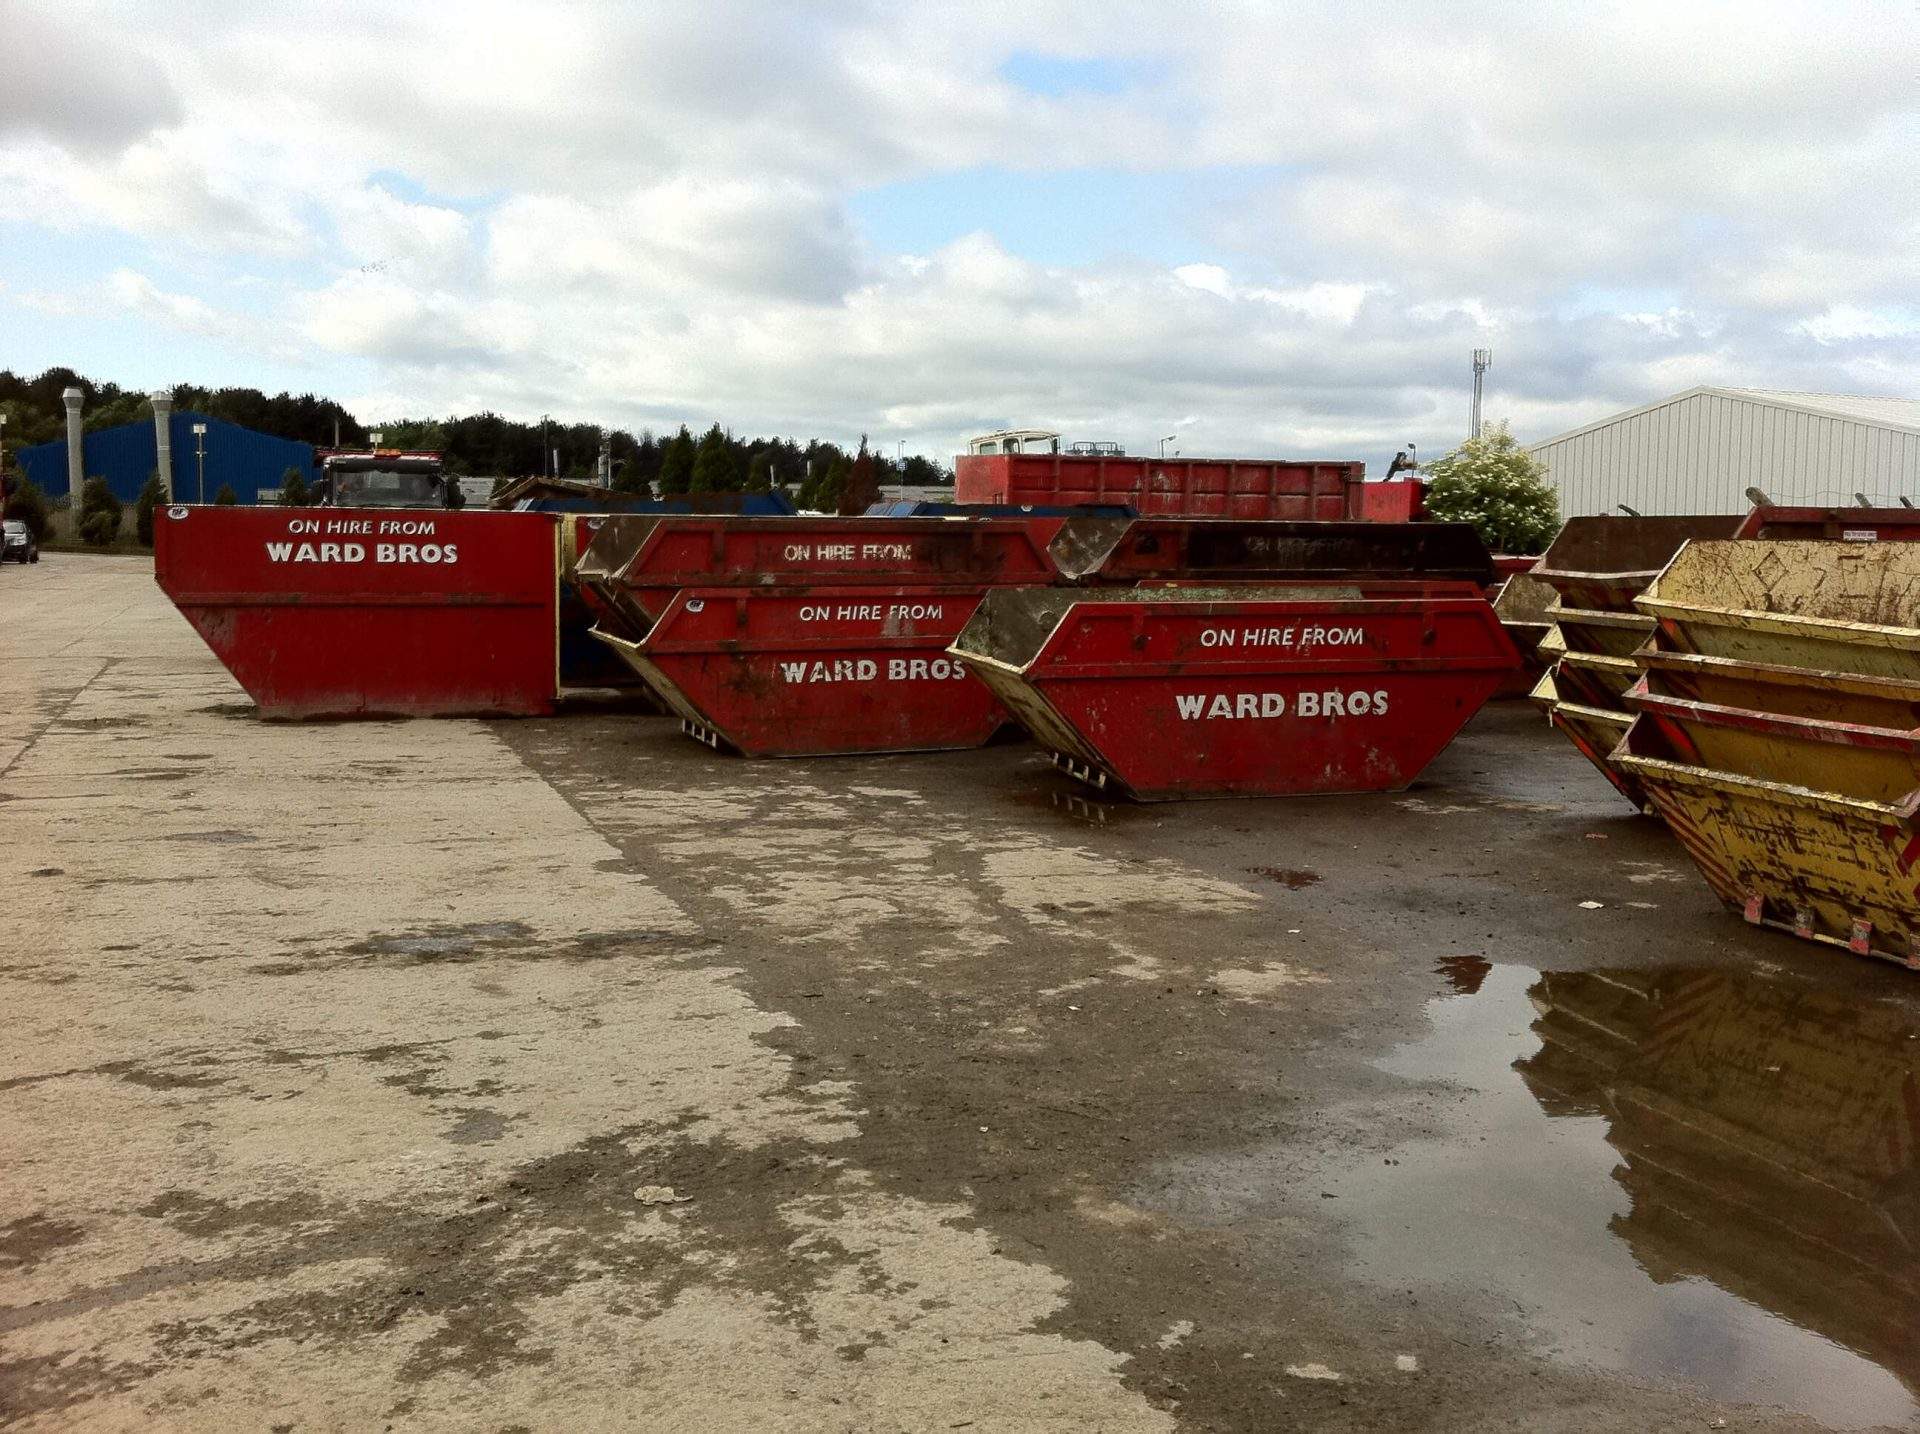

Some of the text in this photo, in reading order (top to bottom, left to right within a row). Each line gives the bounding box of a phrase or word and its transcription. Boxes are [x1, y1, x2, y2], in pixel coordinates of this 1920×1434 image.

[288, 519, 436, 536] ON HIRE FROM
[266, 541, 459, 565] WARD BROS
[783, 544, 811, 561] ON
[816, 544, 856, 561] HIRE
[799, 603, 943, 622] ON HIRE FROM
[1200, 627, 1364, 647] ON HIRE FROM
[780, 658, 967, 684] WARD BROS
[1175, 690, 1389, 720] WARD BROS
